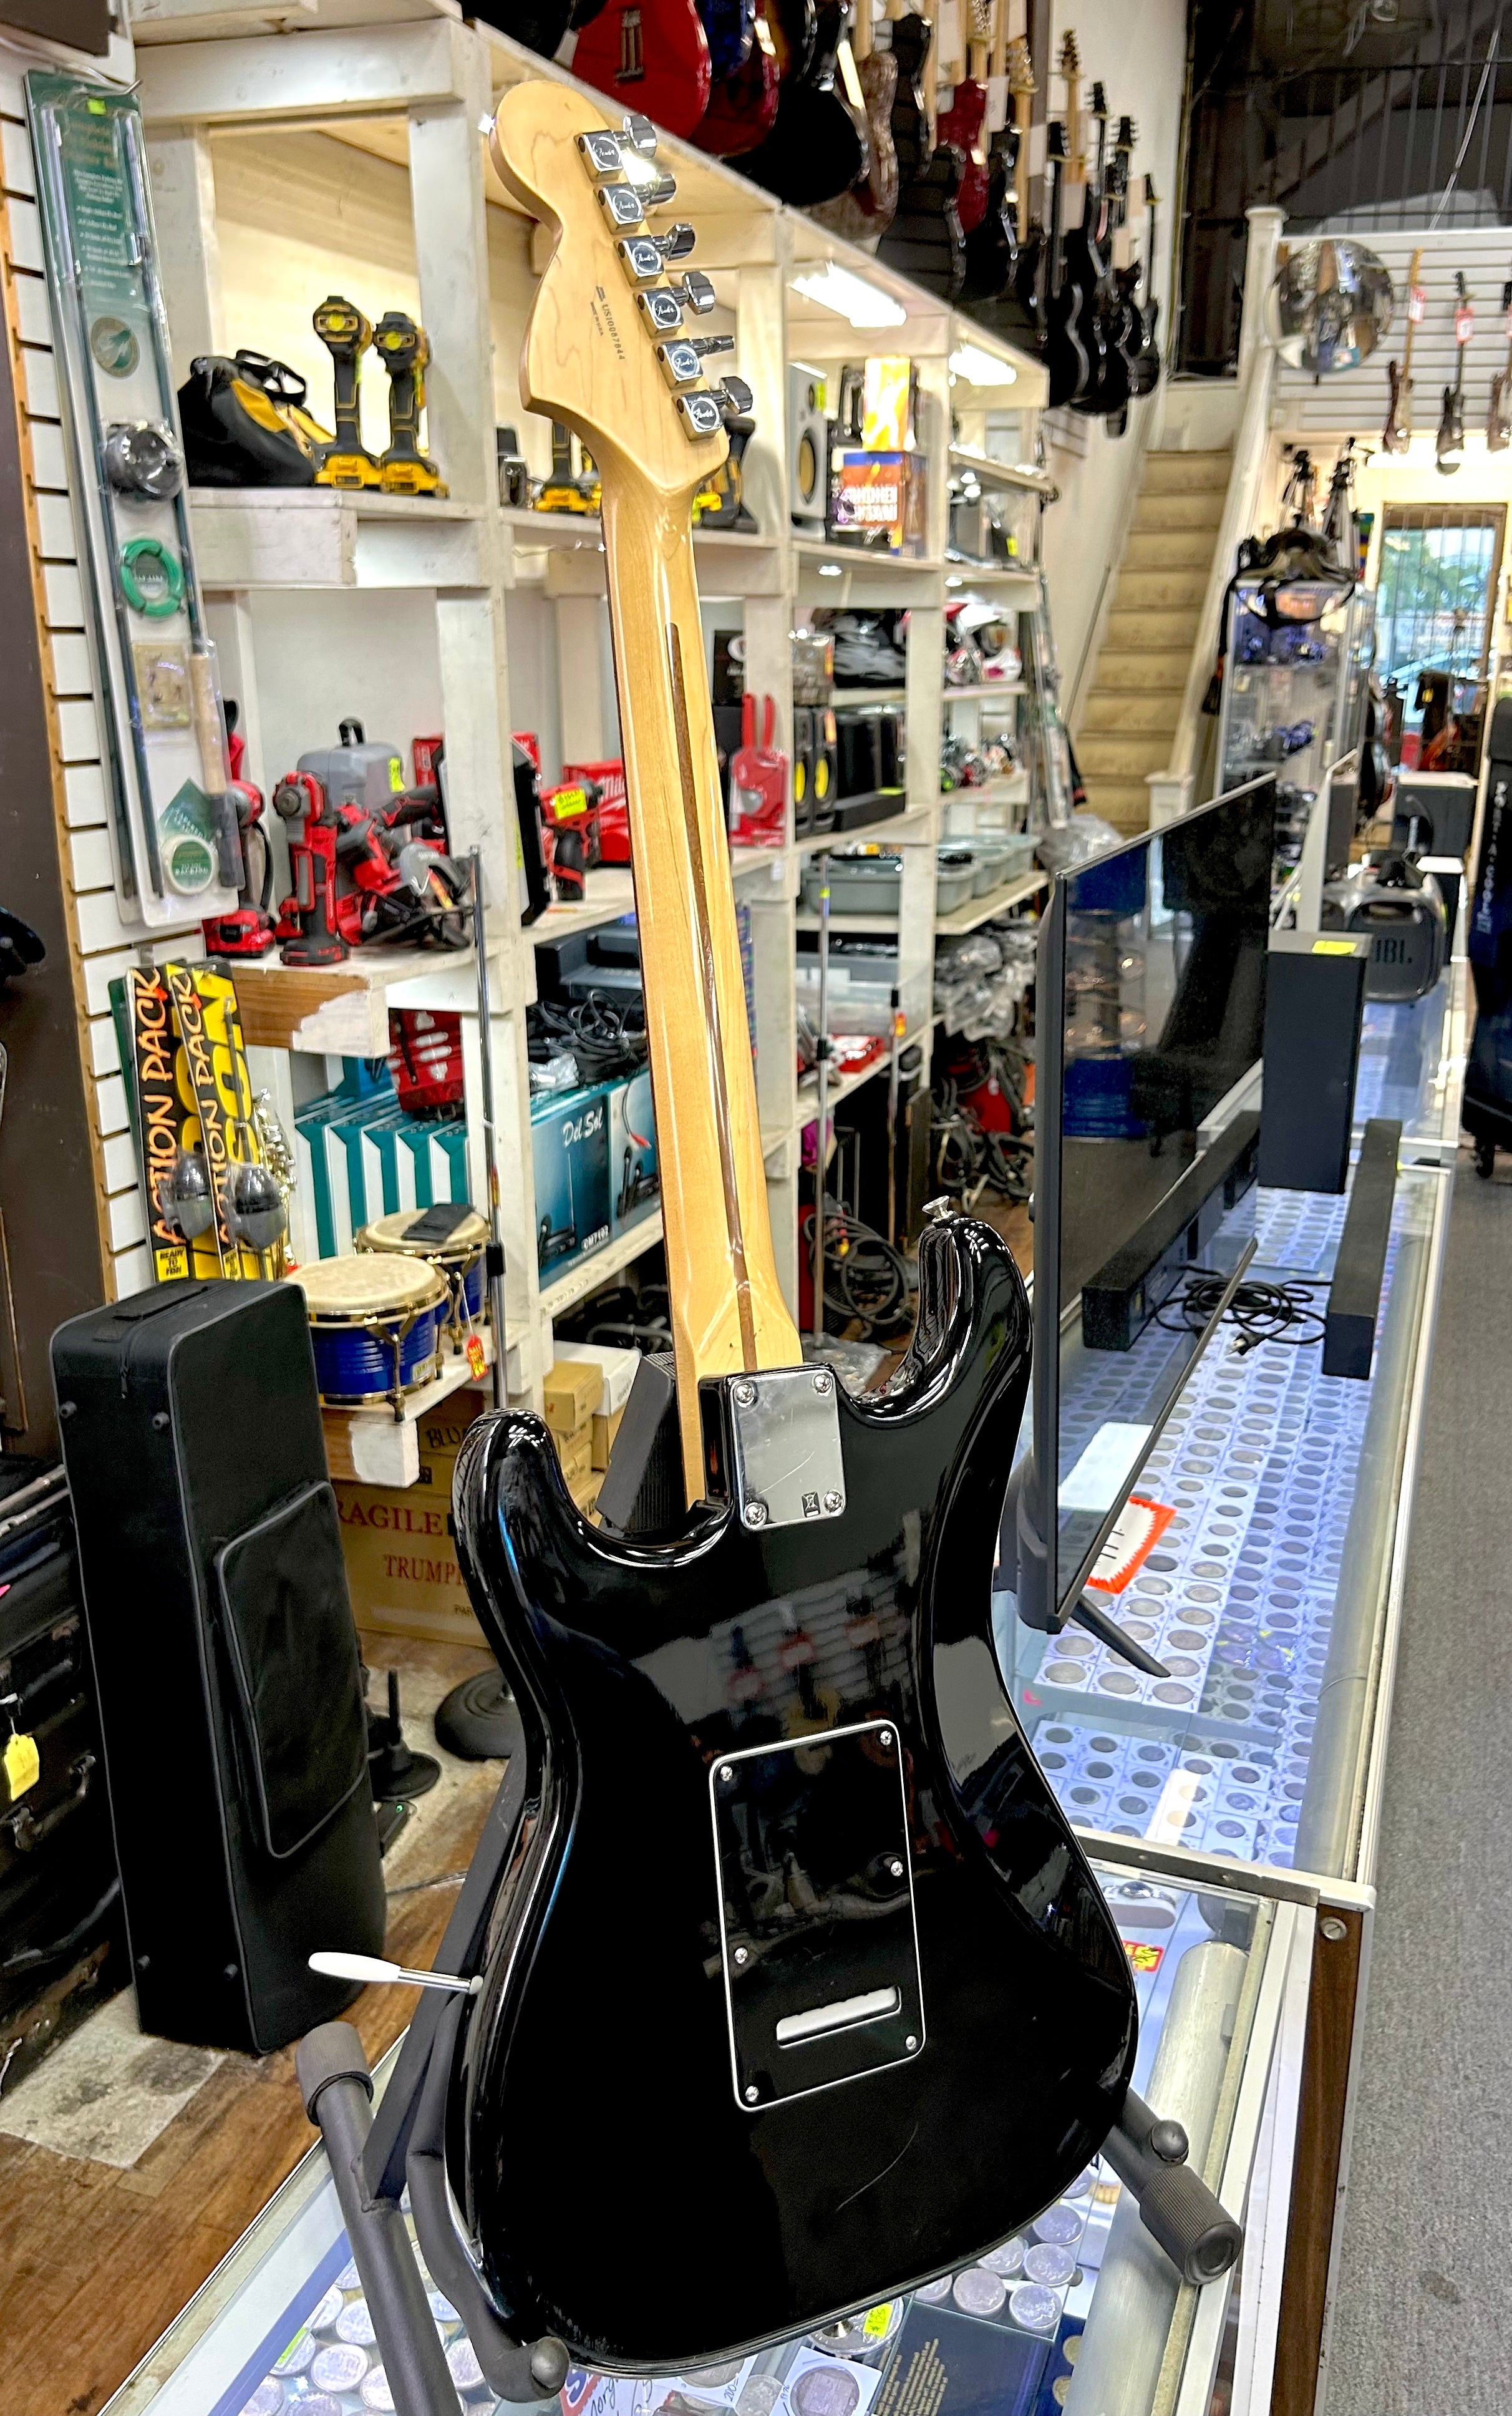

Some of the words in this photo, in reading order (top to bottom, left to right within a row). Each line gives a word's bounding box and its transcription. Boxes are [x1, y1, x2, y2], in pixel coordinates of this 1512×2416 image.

[132, 967, 173, 1082] PACK
[172, 972, 215, 1087] PACK
[562, 1116, 583, 1148] Del
[584, 1106, 603, 1139] Sol
